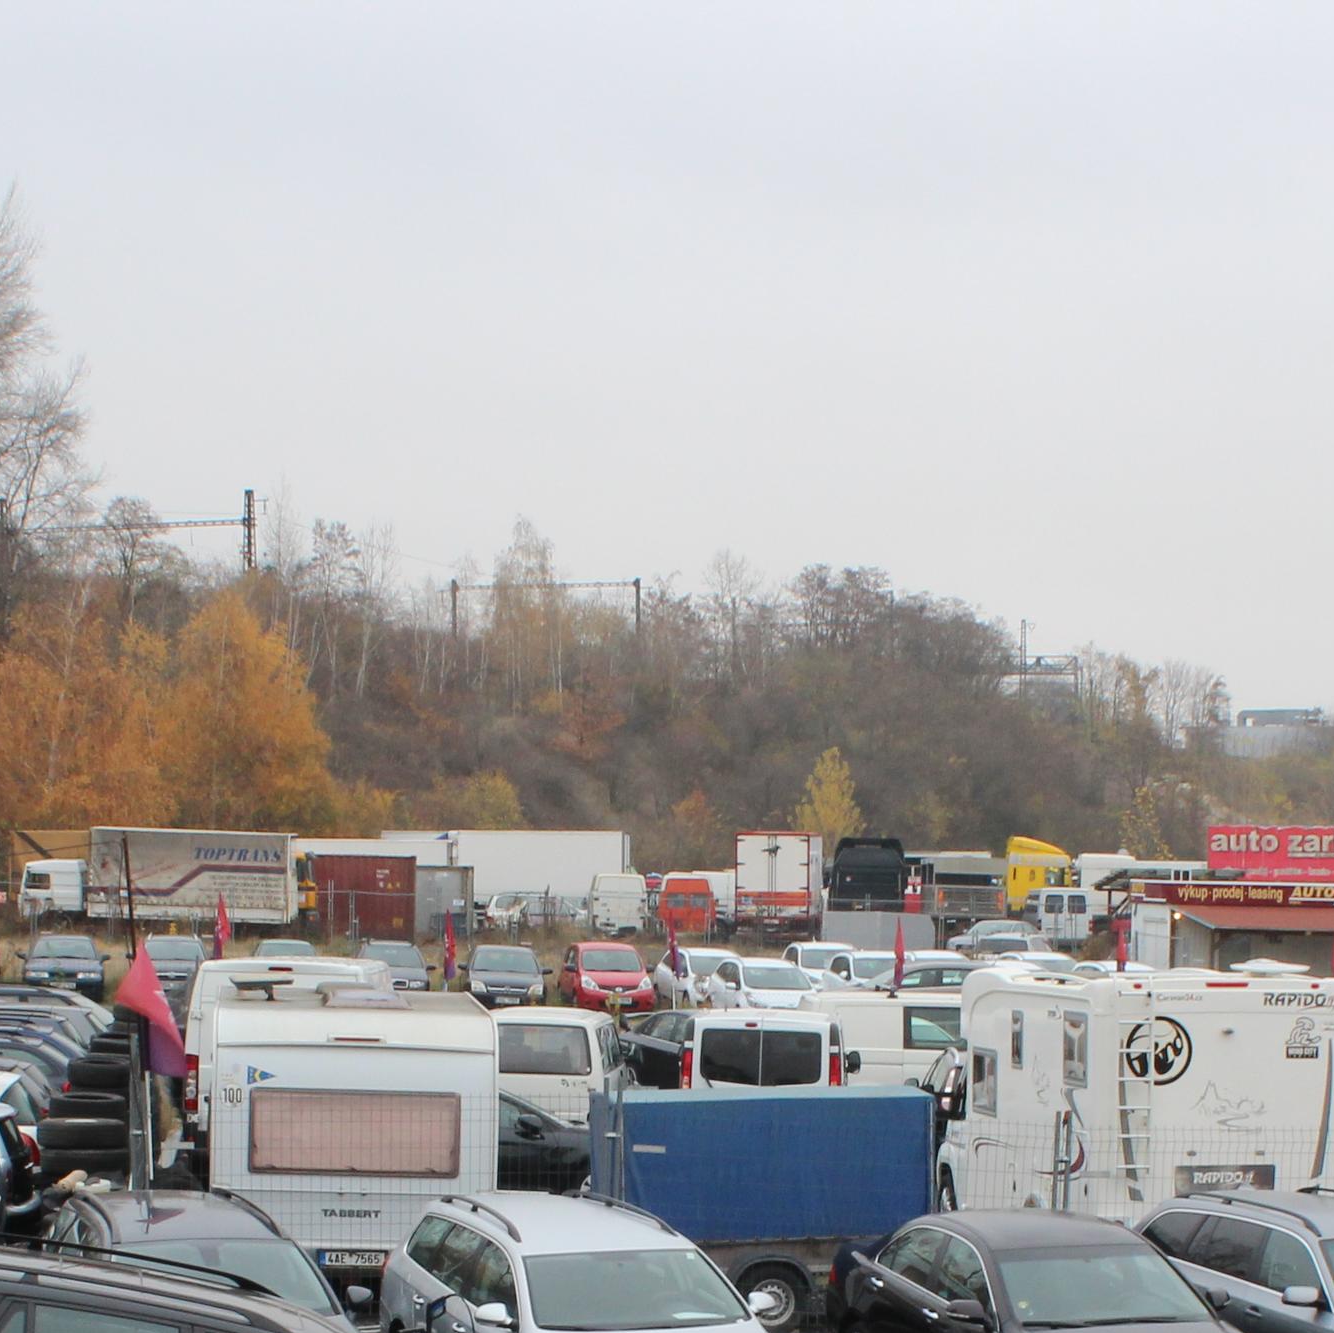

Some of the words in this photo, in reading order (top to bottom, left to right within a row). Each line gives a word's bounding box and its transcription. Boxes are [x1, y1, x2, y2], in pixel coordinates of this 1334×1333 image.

[1210, 830, 1279, 853] auto
[194, 846, 283, 863] TOPTRANS
[1212, 886, 1244, 902] prodej
[1247, 886, 1284, 903] leasing
[223, 1087, 243, 1103] 100
[1192, 1171, 1243, 1184] RAPIDO
[321, 1208, 381, 1219] TABBERT
[327, 1251, 347, 1265] 4AE
[355, 1251, 380, 1265] 7565
